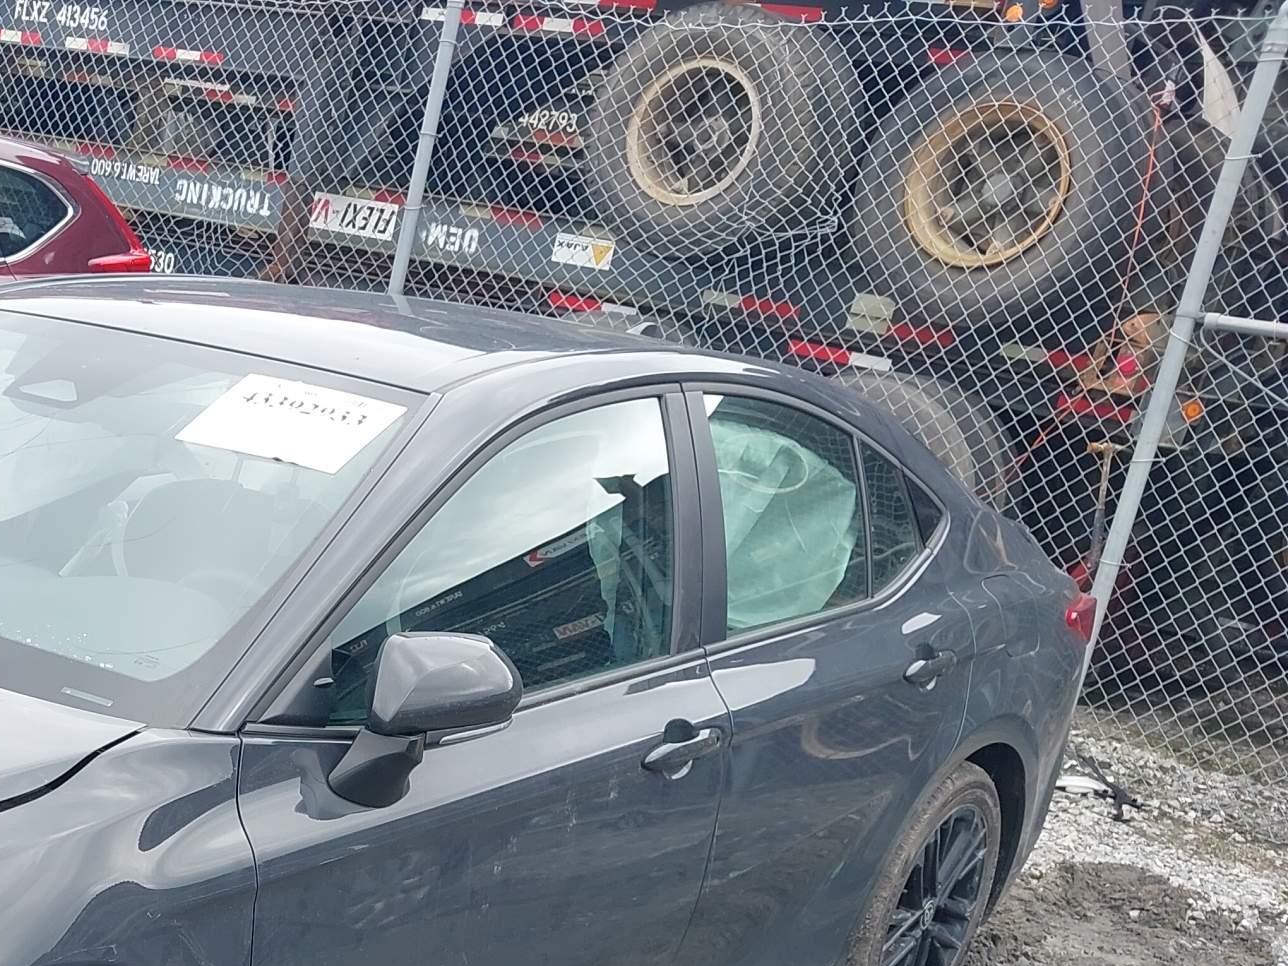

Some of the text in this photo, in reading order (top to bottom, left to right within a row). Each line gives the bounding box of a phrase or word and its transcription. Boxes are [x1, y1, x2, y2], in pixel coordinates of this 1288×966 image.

[13, 0, 109, 31] FLXZ 413456
[175, 178, 271, 217] TRUCKING
[146, 248, 175, 274] 530
